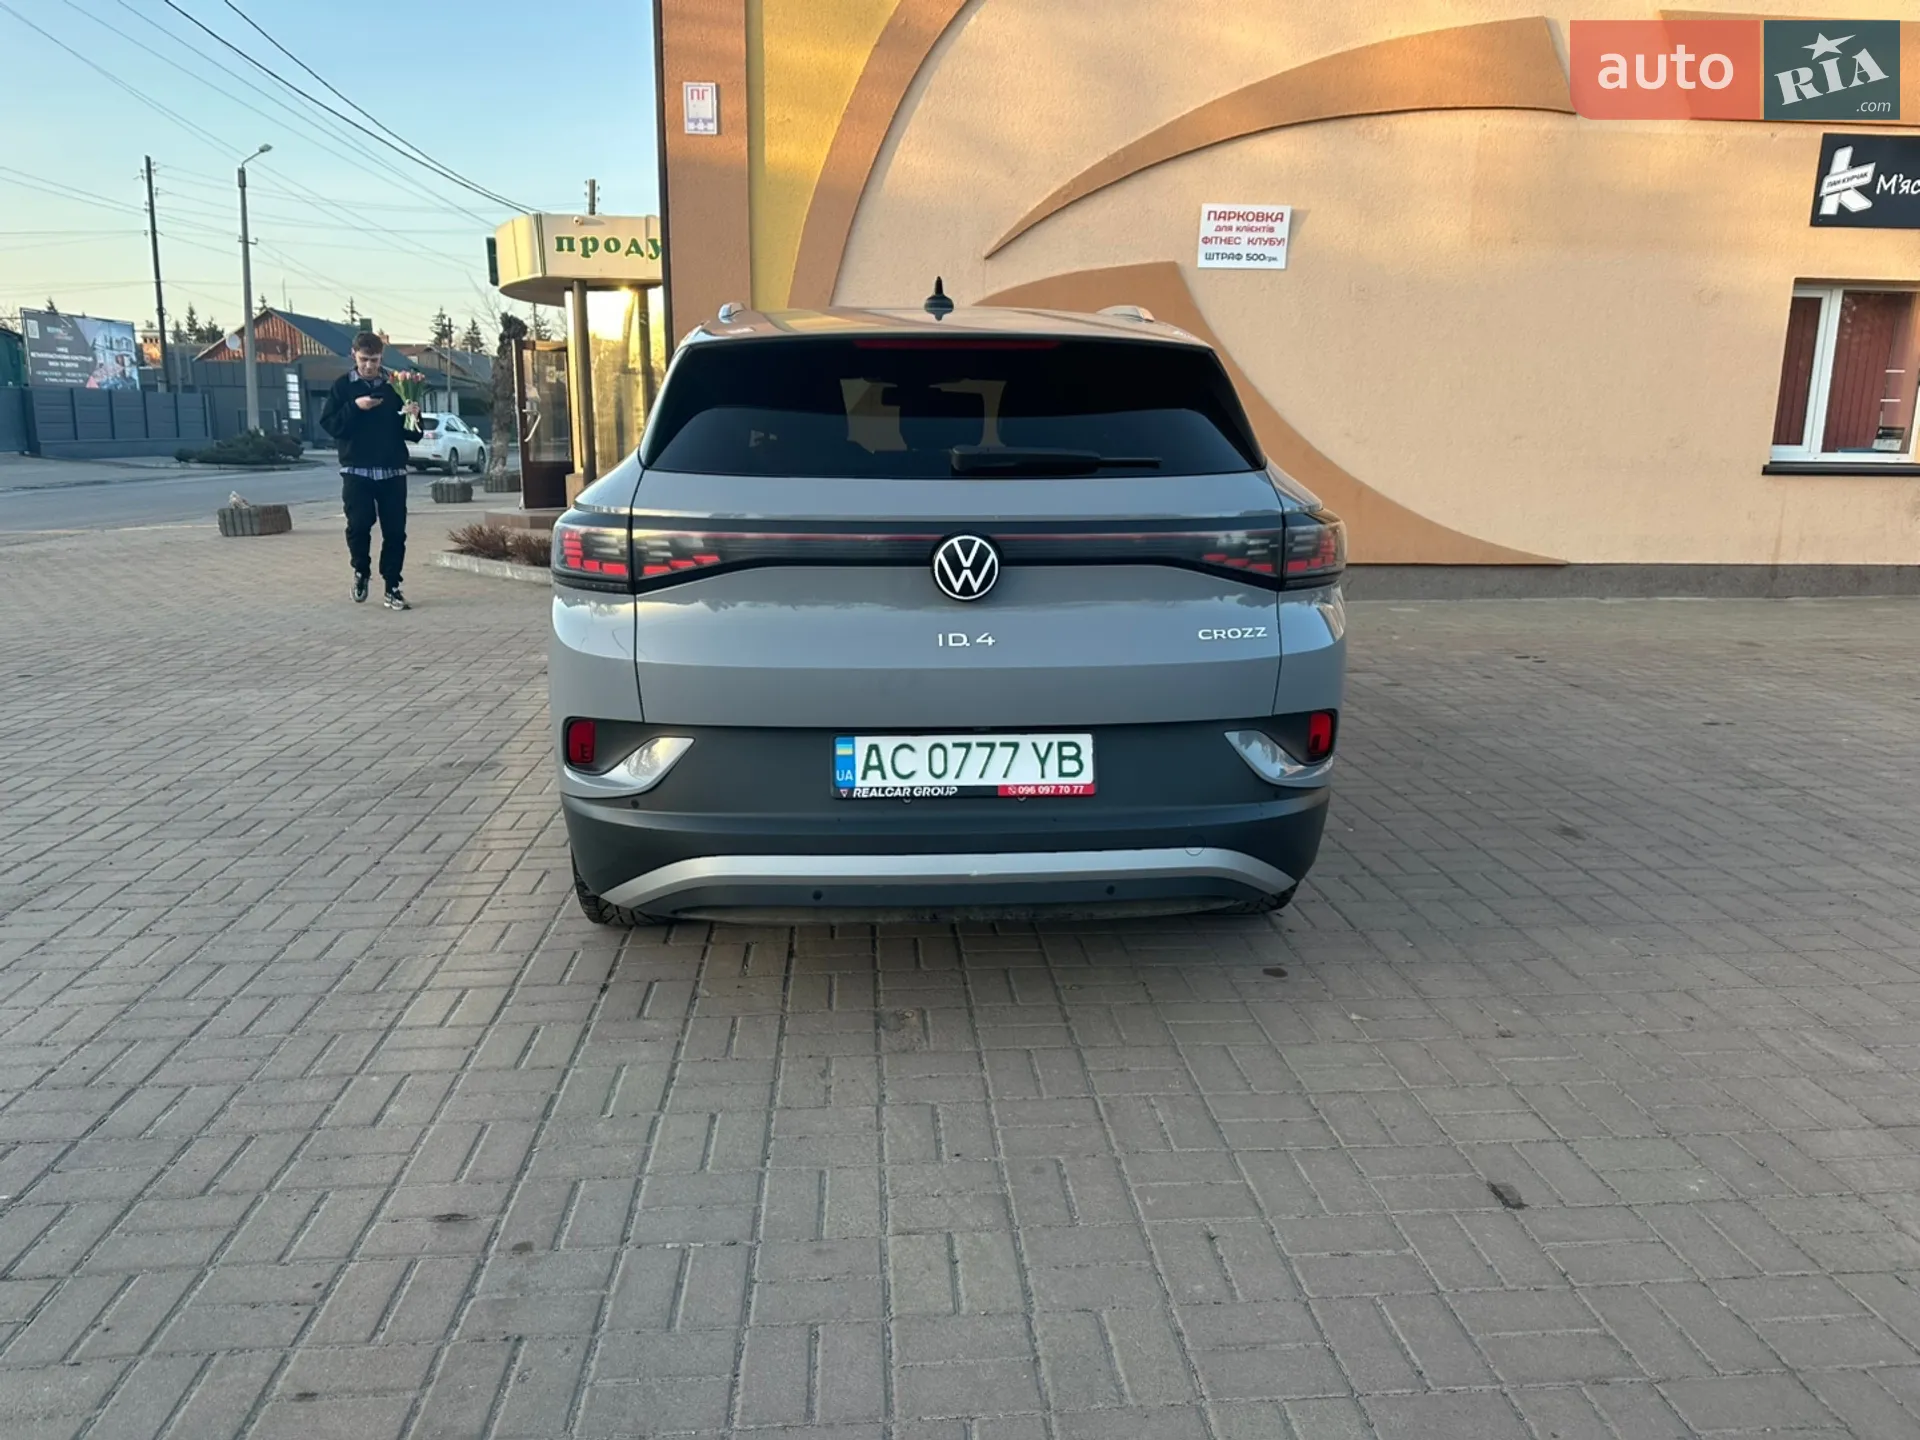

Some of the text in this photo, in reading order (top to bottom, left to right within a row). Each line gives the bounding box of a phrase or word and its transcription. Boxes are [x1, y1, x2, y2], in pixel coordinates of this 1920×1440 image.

[690, 88, 709, 101] ПГ
[1207, 211, 1284, 222] ПАРКОВКА
[1236, 224, 1275, 233] клієнтів
[555, 235, 661, 260] проду
[1201, 236, 1285, 247] ФІТНЕС КЛУБУ!
[1205, 252, 1243, 261] ШТРАФ
[1198, 626, 1268, 641] CROZZ
[860, 741, 1085, 781] AC 0777 YB
[836, 769, 854, 782] UA
[853, 786, 958, 798] REALCAR GROUP
[1017, 785, 1085, 795] 096 097 70 77
